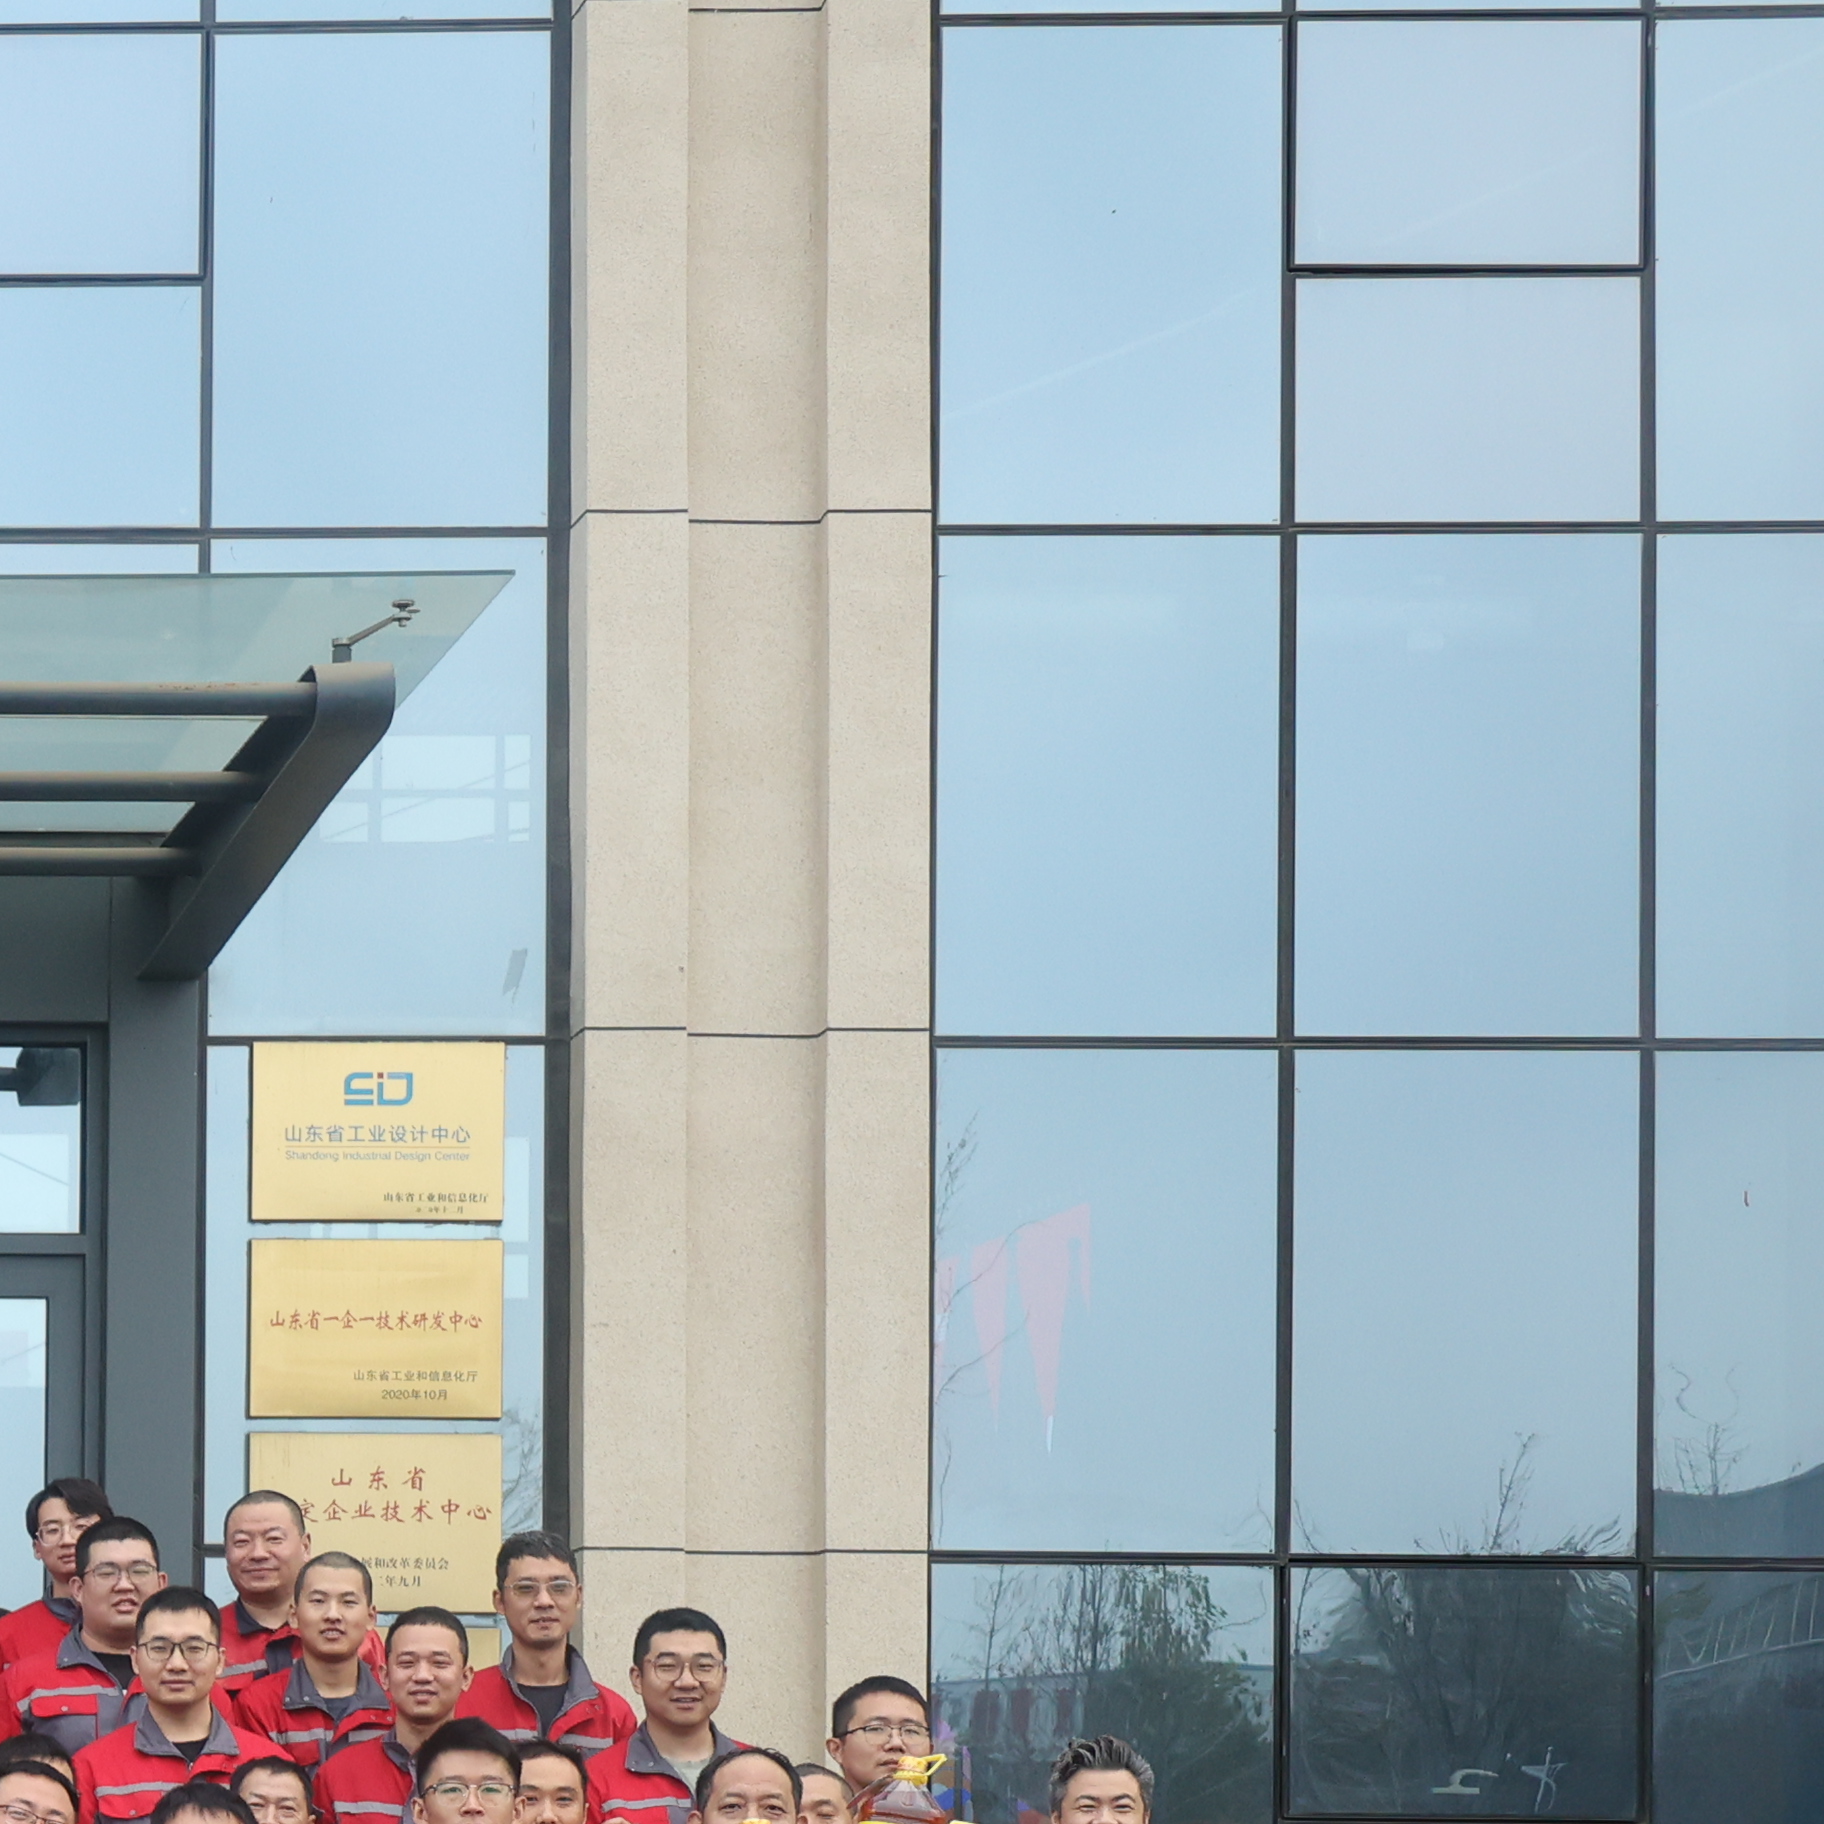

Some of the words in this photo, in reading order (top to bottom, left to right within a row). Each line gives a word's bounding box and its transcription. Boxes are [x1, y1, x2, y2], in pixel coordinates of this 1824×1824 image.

[284, 1124, 471, 1144] 山东省工业设计中心
[284, 1150, 340, 1162] Shandong
[343, 1150, 392, 1161] Industrial
[395, 1151, 431, 1162] Design
[435, 1151, 470, 1161] Center
[383, 1191, 489, 1204] 山东省工业和信息化厅
[269, 1308, 483, 1333] 山东省一企一技术研发中心
[352, 1369, 479, 1383] 山东省工业和信息化厅
[381, 1388, 448, 1401] 2020年10月
[331, 1465, 427, 1492] 山东省
